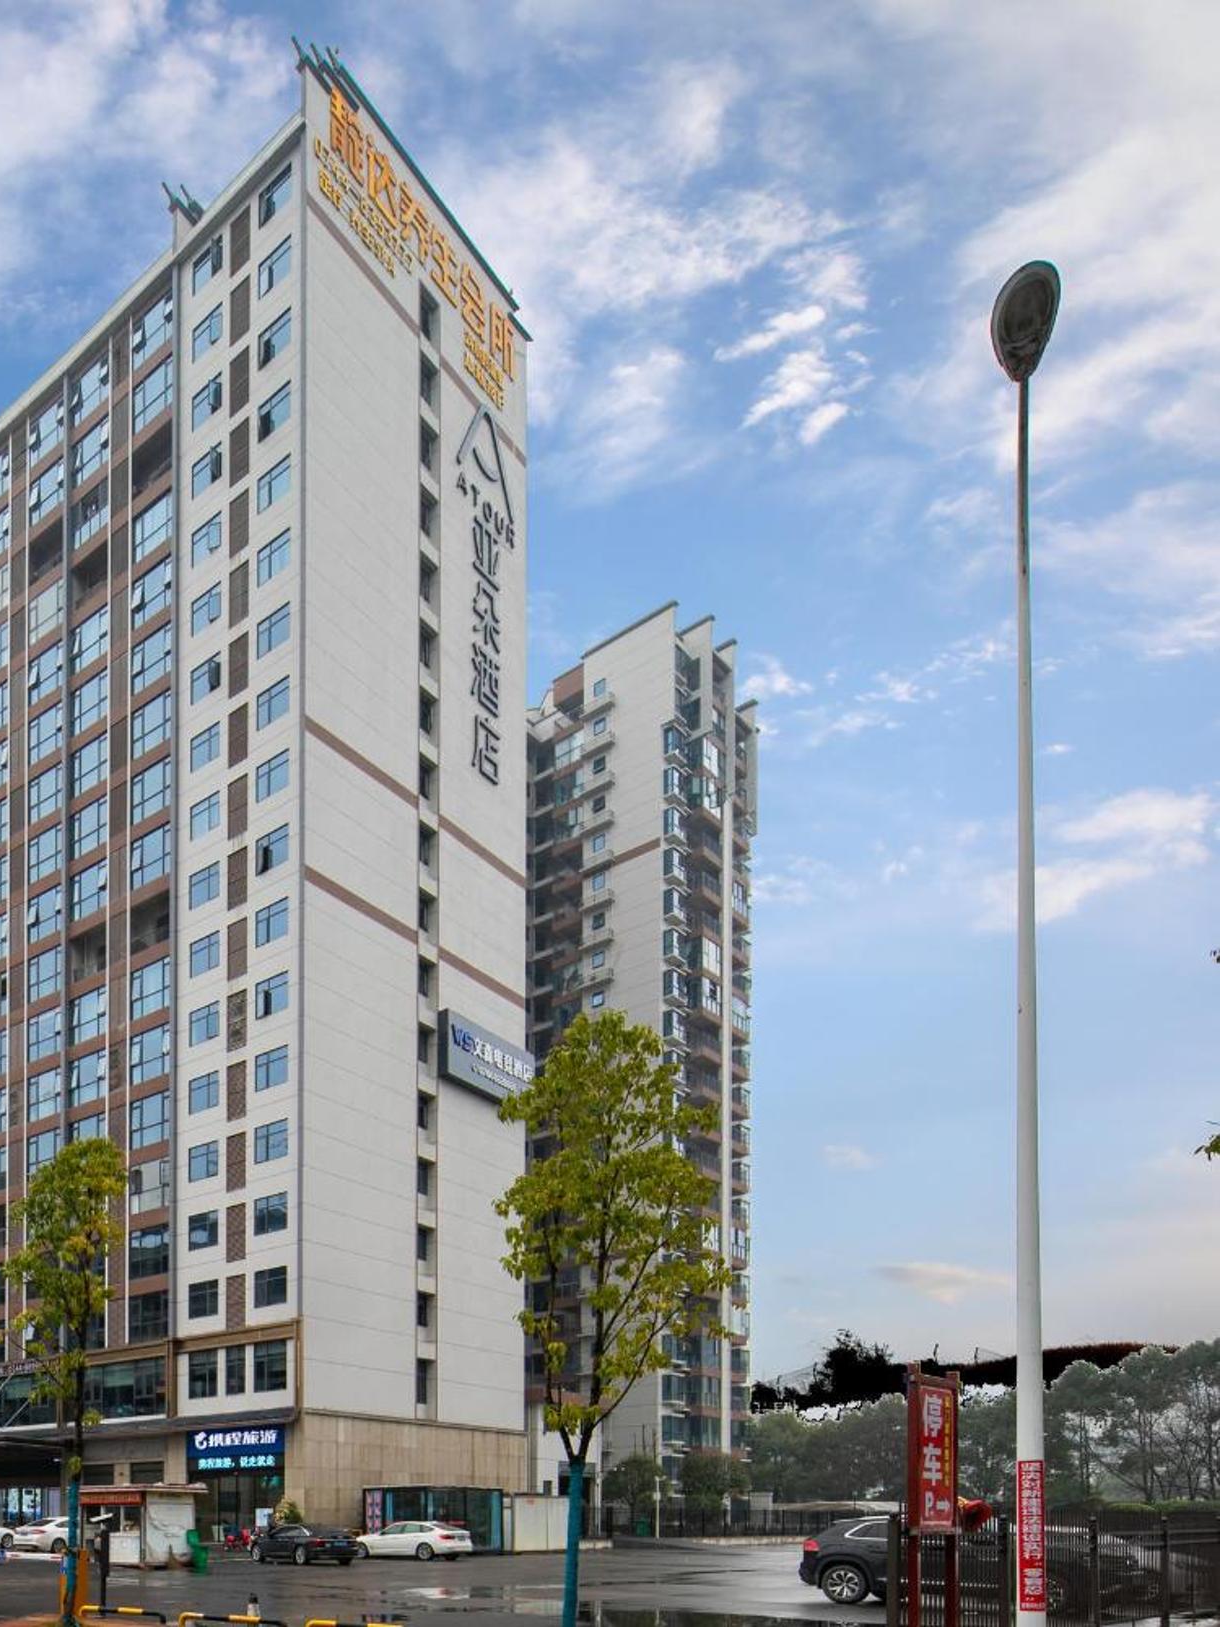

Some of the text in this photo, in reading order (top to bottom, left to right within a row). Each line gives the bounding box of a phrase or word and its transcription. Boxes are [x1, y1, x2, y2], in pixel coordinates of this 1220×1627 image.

[456, 469, 515, 549] ATOUR
[470, 514, 501, 787] 亚朵酒店
[207, 1429, 277, 1447] 携程旅游
[922, 1393, 942, 1486] 停车
[925, 1491, 934, 1517] P
